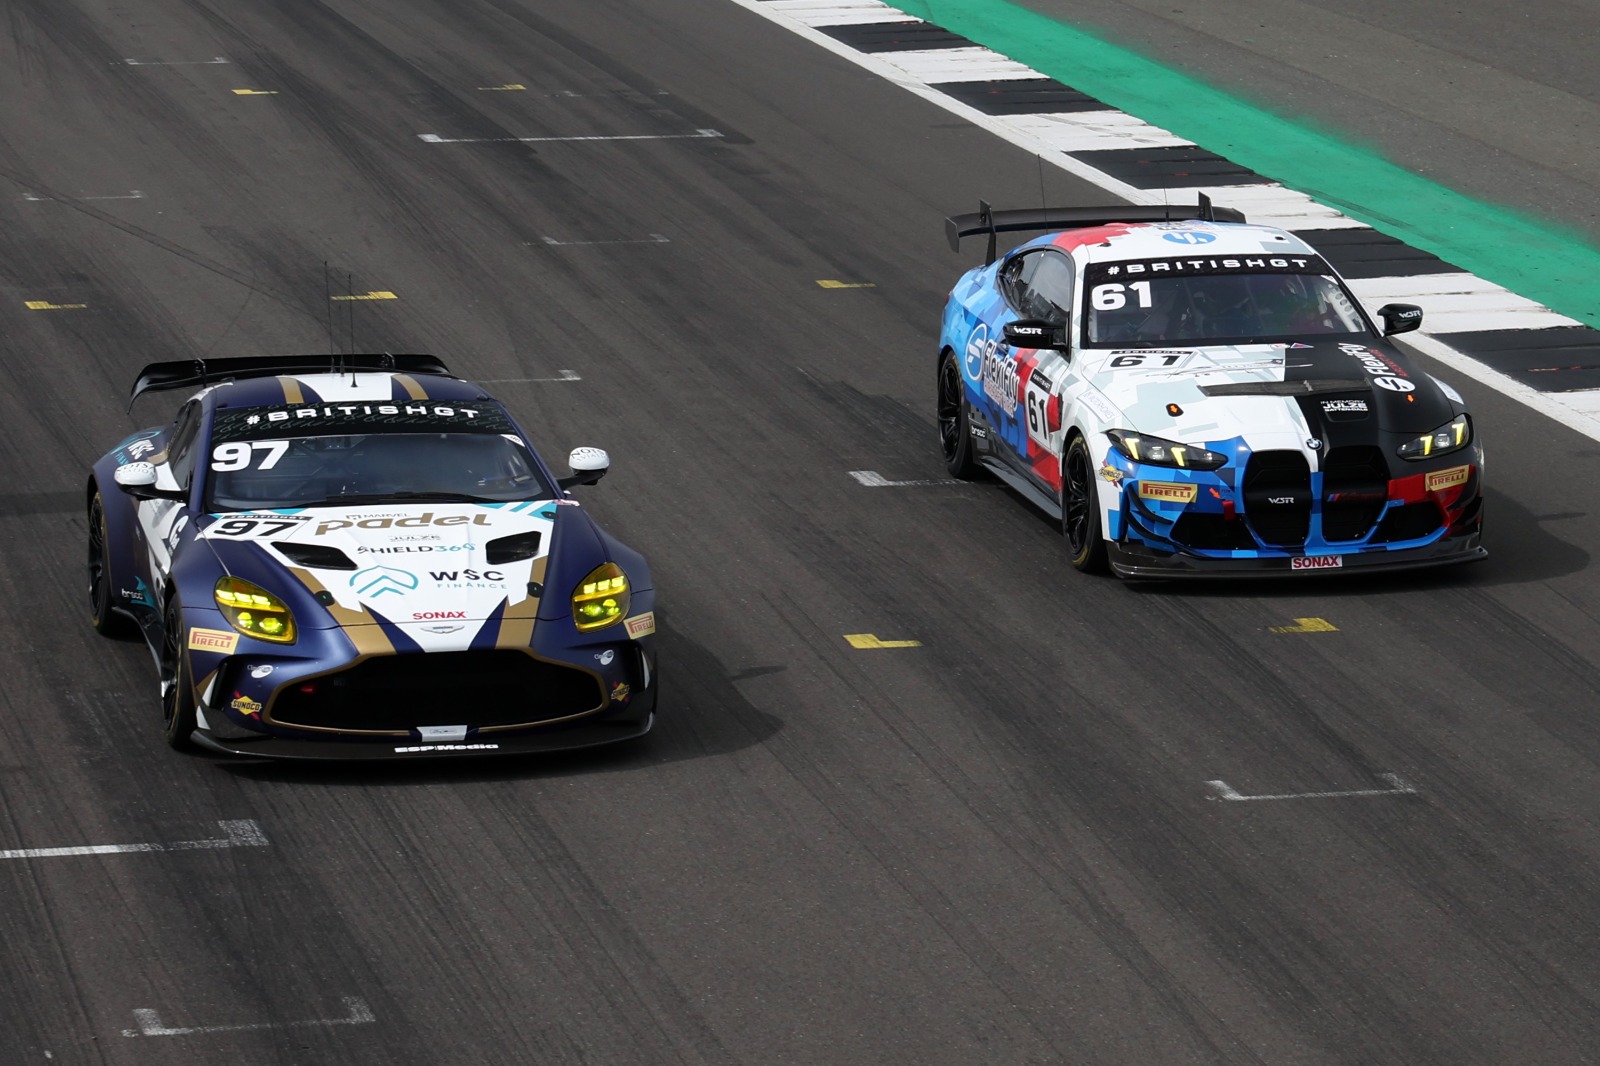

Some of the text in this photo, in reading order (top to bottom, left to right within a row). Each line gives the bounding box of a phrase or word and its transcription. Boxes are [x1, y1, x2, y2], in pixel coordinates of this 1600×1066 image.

[1107, 259, 1307, 275] #BRITISHGT
[1091, 281, 1152, 311] 61
[1398, 310, 1421, 318] WSR
[1013, 326, 1042, 335] WSR
[1110, 355, 1181, 367] 61
[247, 405, 479, 425] #BRITISHGT
[1028, 391, 1047, 440] 61
[211, 440, 289, 472] 97
[1429, 469, 1465, 486] PIRELLI
[1143, 483, 1192, 498] PIRELLI
[213, 520, 299, 536] 97
[315, 513, 492, 536] padel
[1293, 556, 1339, 568] SONAX
[429, 569, 505, 581] WSC
[413, 611, 467, 620] SONAX
[191, 631, 233, 648] PIRELLI
[232, 699, 261, 711] SUNOCO
